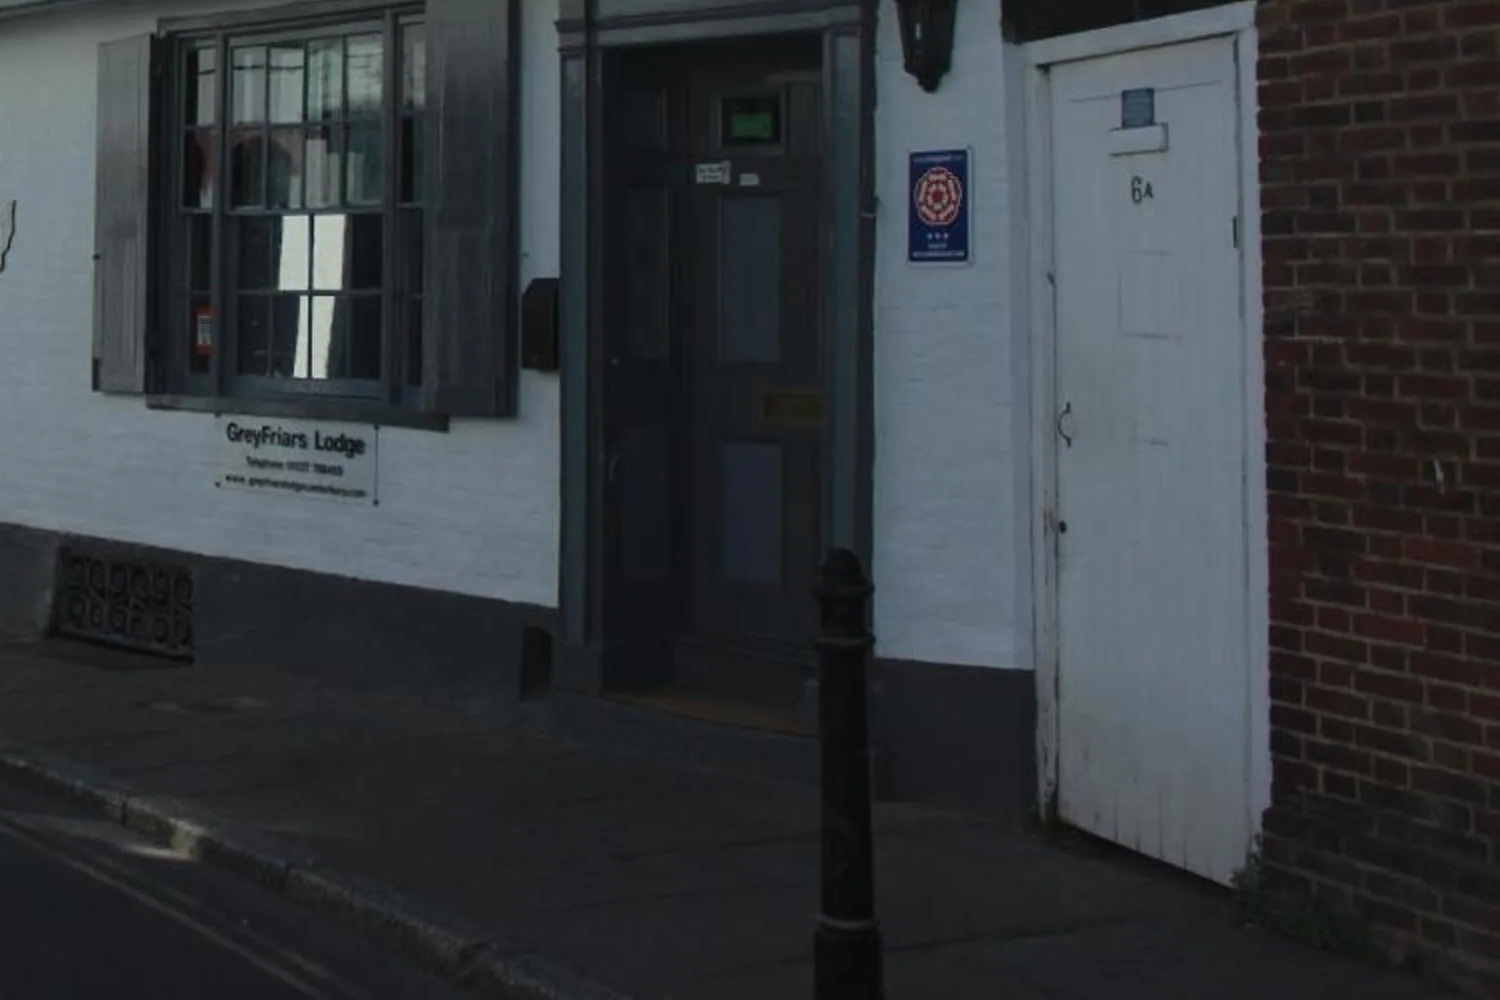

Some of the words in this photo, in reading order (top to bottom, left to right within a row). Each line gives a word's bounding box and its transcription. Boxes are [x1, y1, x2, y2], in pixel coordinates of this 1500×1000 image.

[1130, 175, 1154, 204] 6A
[226, 421, 308, 449] GreyFriars
[315, 429, 366, 459] Lodge
